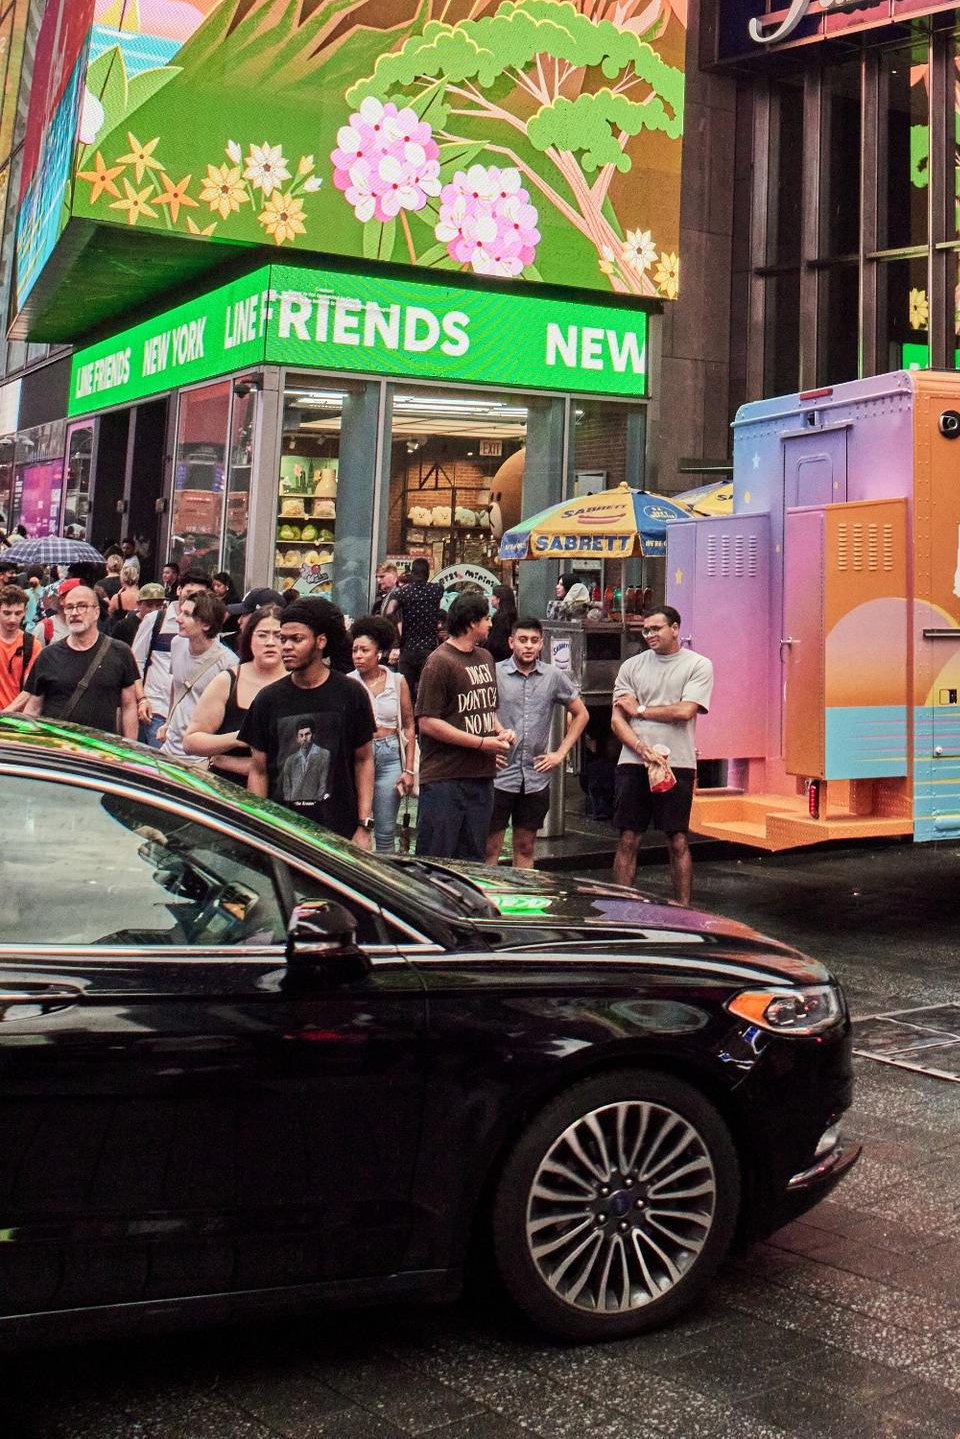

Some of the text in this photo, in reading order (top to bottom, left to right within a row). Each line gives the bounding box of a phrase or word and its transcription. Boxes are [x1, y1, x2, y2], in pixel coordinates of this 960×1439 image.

[224, 294, 259, 350] LINE
[258, 289, 471, 357] FRIENDS
[142, 316, 207, 377] NEW YORK
[545, 322, 646, 374] NEW
[75, 346, 131, 399] LINE FRIENDS
[482, 441, 501, 455] EXIT
[561, 504, 628, 519] SABRETT
[535, 535, 632, 552] SABRETT
[464, 663, 493, 686] DIGGY
[464, 714, 482, 735] NO
